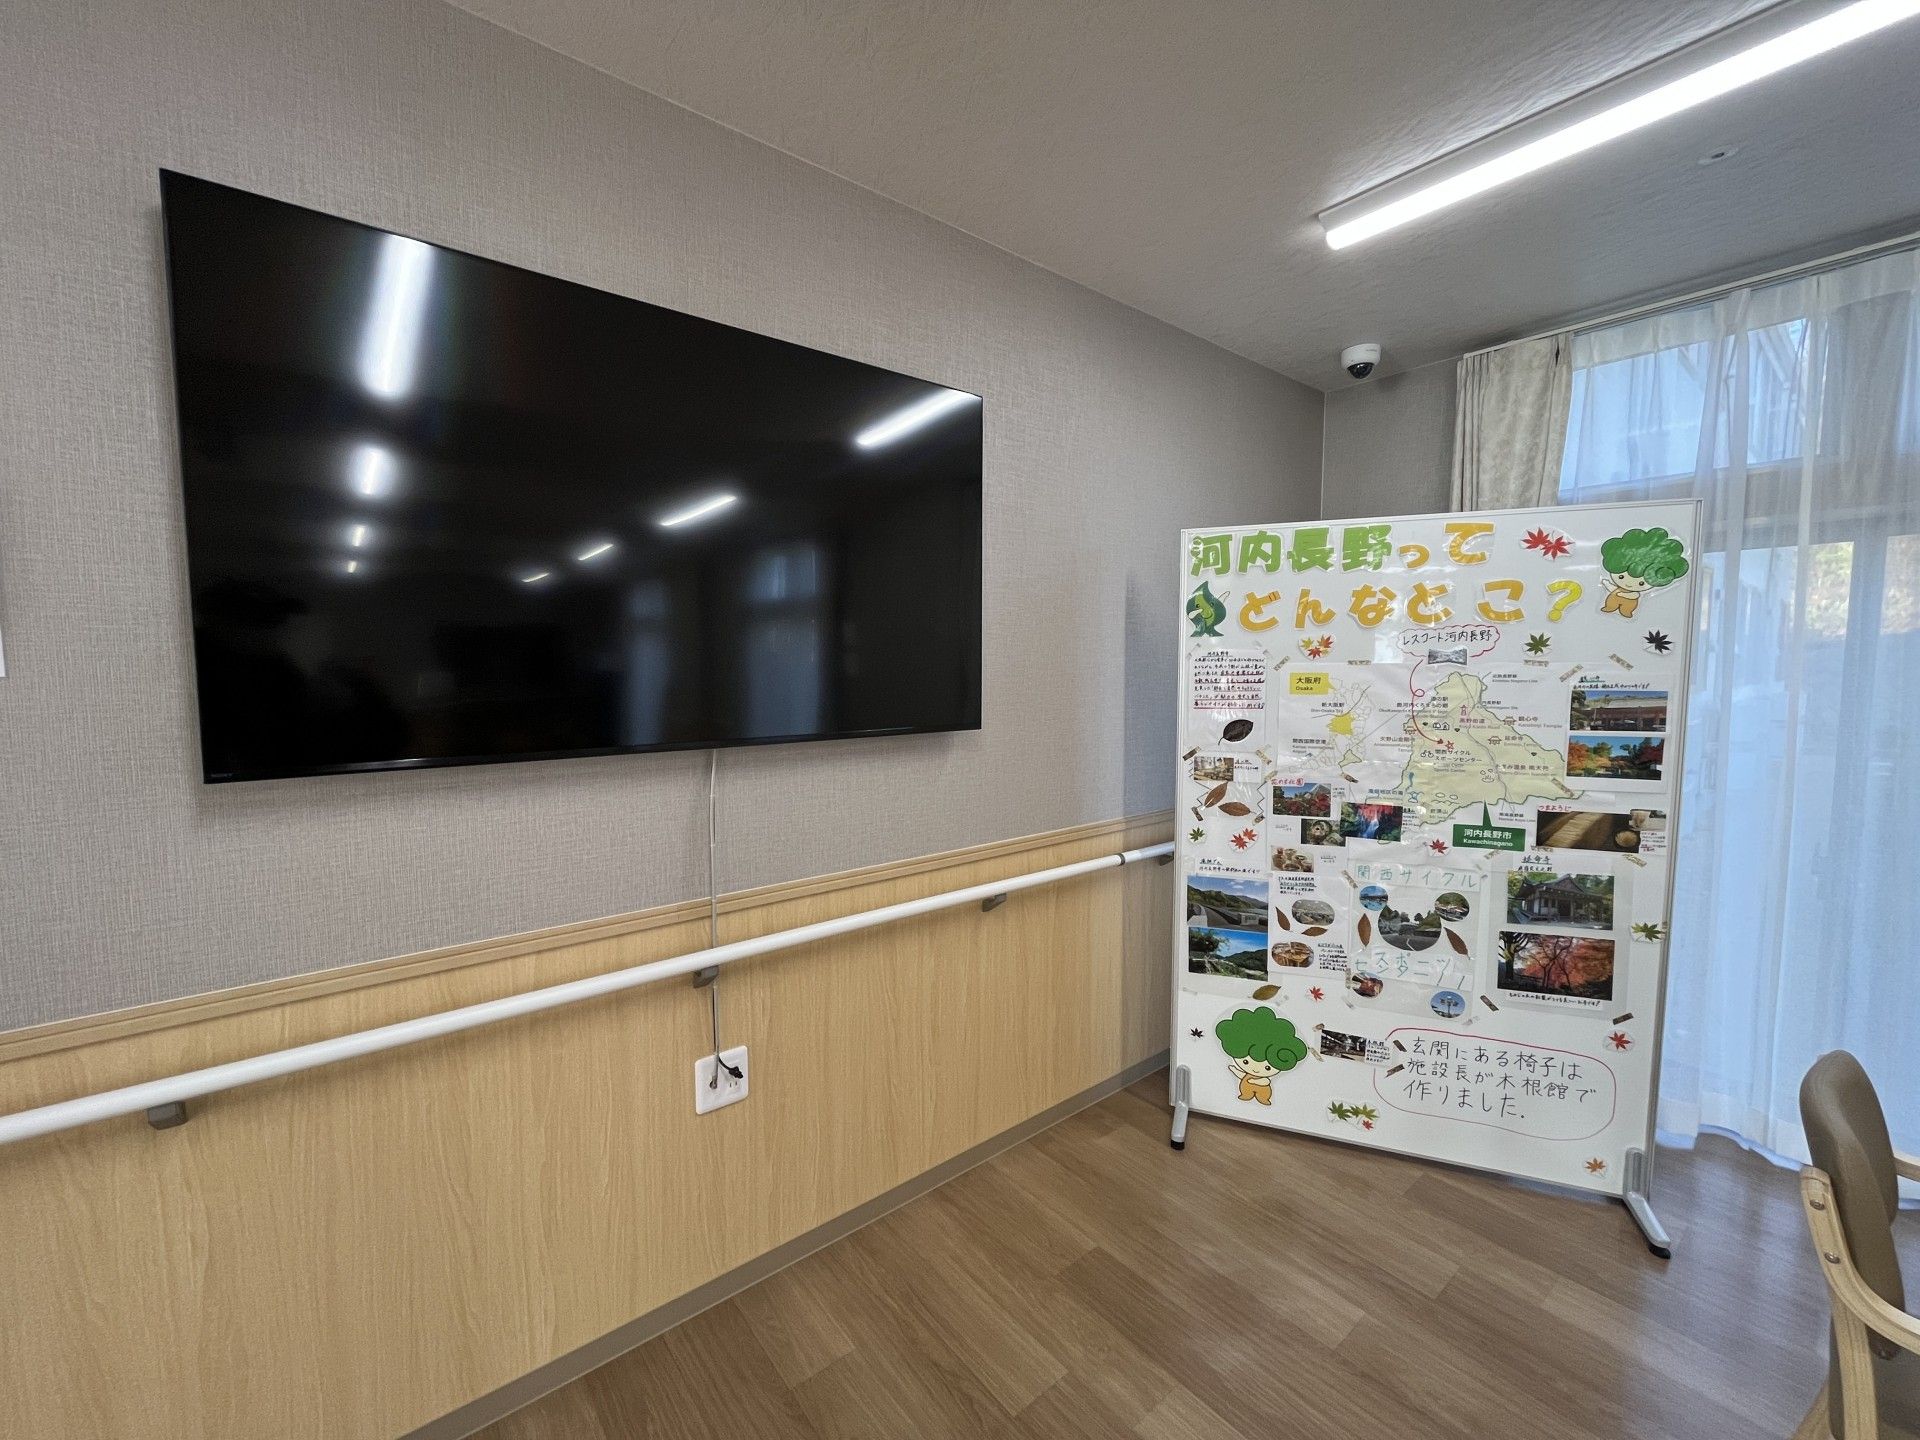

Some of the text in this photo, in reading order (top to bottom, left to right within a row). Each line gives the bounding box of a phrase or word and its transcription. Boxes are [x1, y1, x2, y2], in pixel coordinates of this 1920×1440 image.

[1190, 523, 1495, 576] 河内長野って
[1403, 629, 1493, 645] レスコート河内長野
[1296, 676, 1322, 685] 大阪府
[1463, 838, 1513, 847] Kawachinagano
[1464, 828, 1513, 839] 河内長野市
[1357, 865, 1477, 888] 関西サイクル
[1411, 1036, 1583, 1079] 玄関にある椅子は
[1406, 1057, 1597, 1103] 施設長が木根館で
